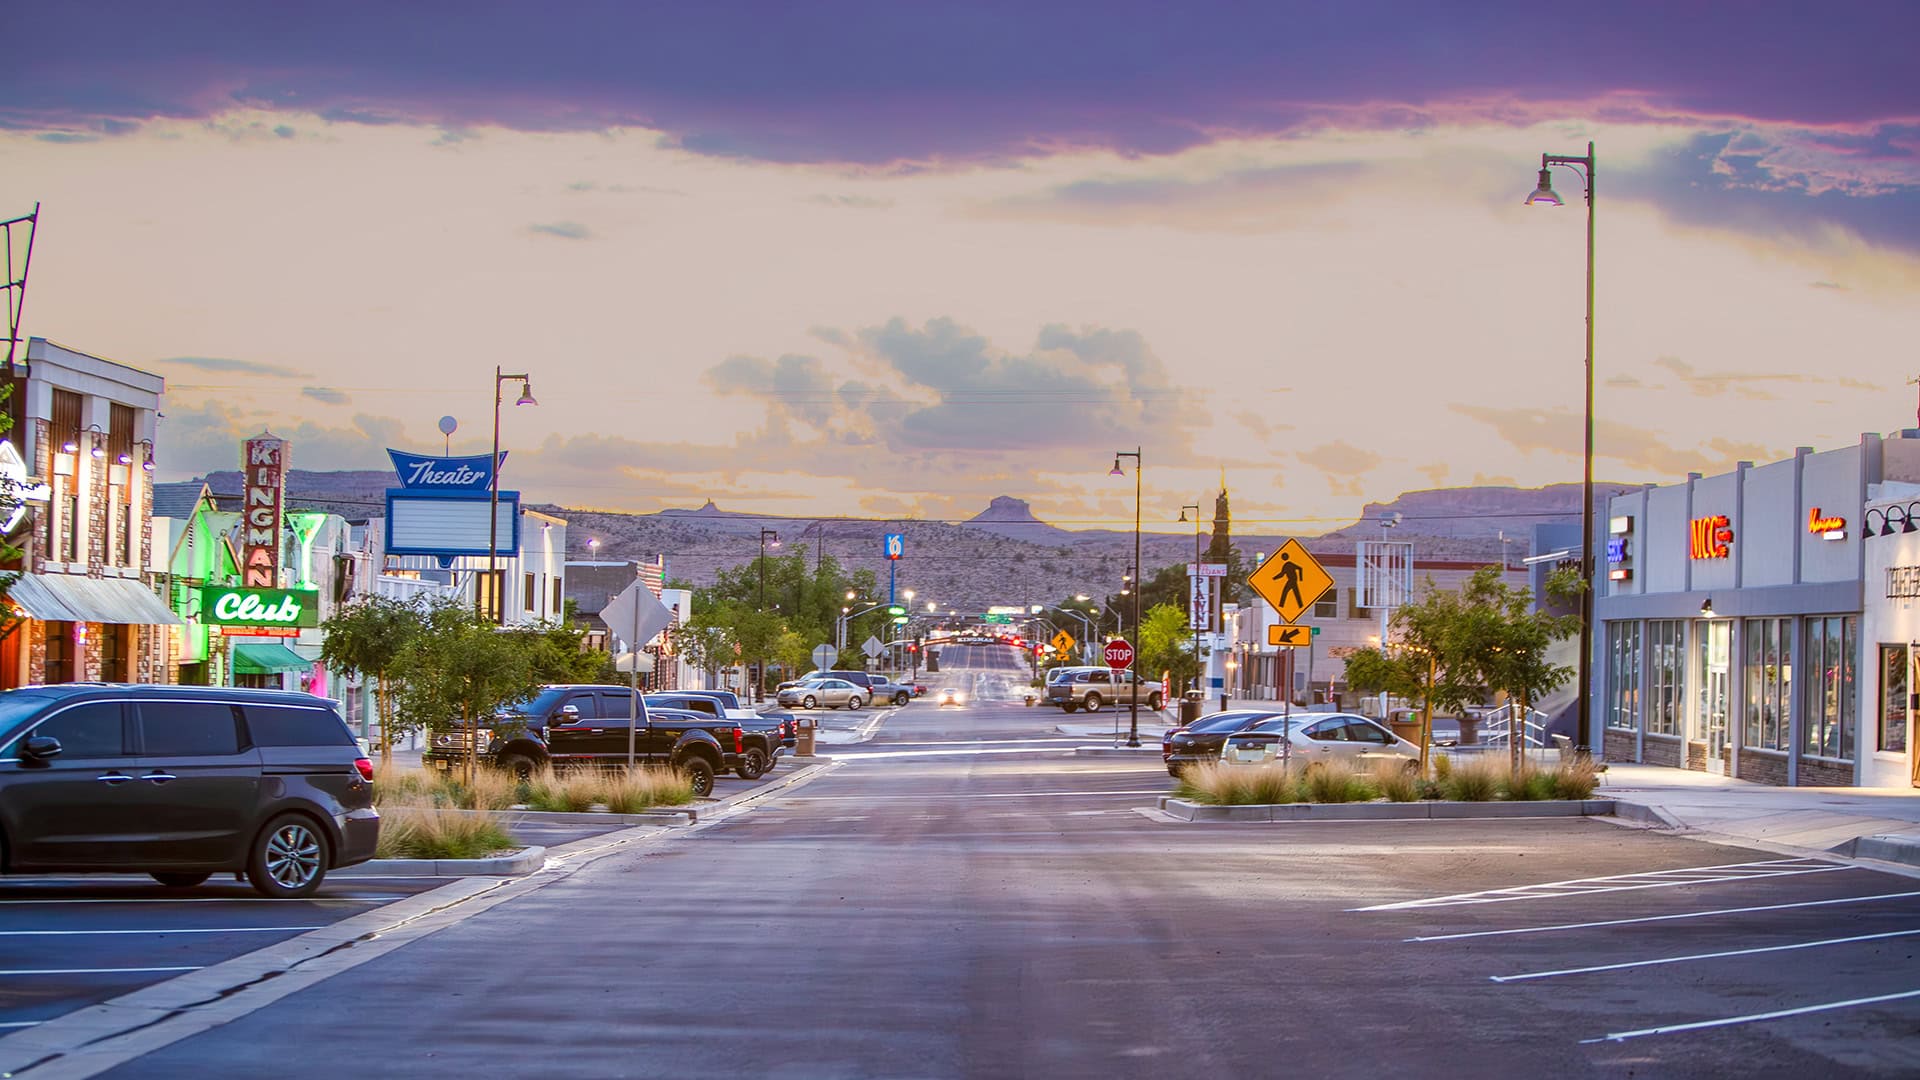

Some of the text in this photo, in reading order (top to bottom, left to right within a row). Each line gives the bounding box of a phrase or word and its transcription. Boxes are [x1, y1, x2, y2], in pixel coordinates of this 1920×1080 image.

[407, 460, 486, 485] Theater
[248, 446, 276, 587] KINGMAN
[889, 534, 902, 555] 6
[214, 592, 302, 623] Club
[1193, 577, 1207, 623] PAWN
[1105, 648, 1132, 661] STOP
